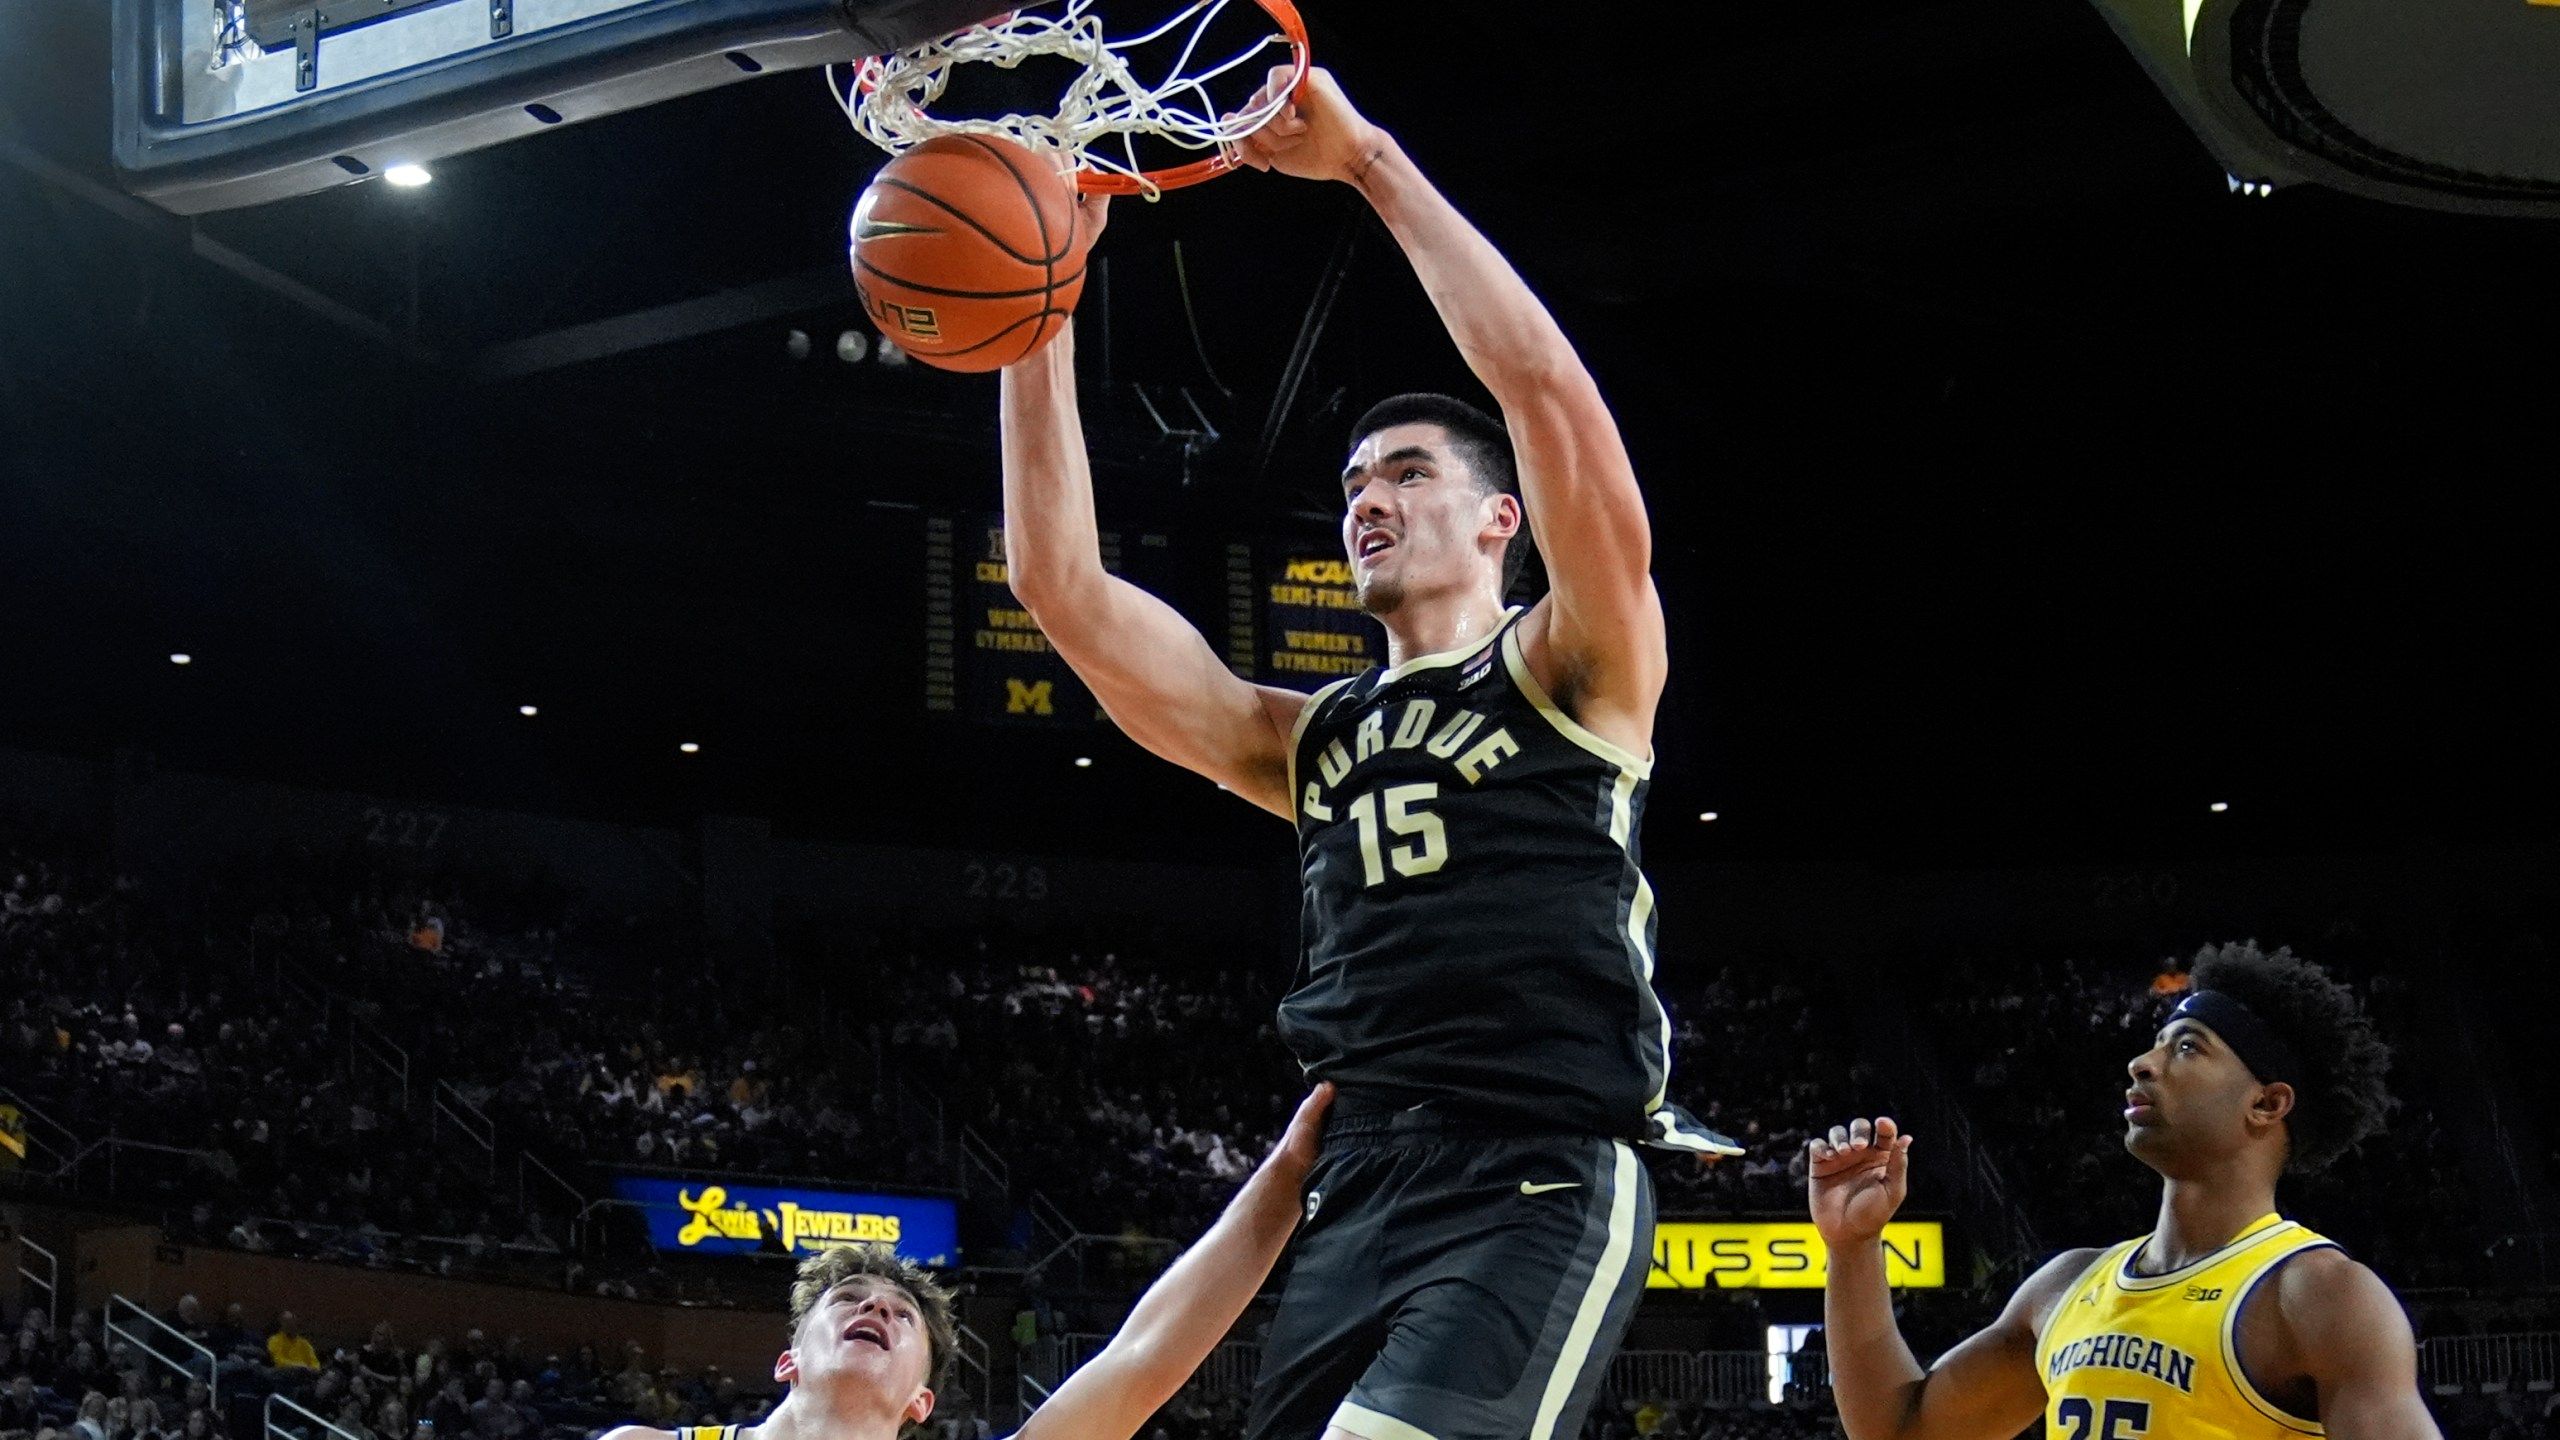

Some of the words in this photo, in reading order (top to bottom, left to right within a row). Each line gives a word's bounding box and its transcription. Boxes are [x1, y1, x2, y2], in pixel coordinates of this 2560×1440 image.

[1005, 677, 1055, 716] M
[1303, 699, 1521, 823] PURDUE
[360, 806, 448, 848] 227
[1350, 782, 1449, 888] 15
[963, 862, 1049, 900] 228
[2048, 1333, 2197, 1394] MICHIGAN
